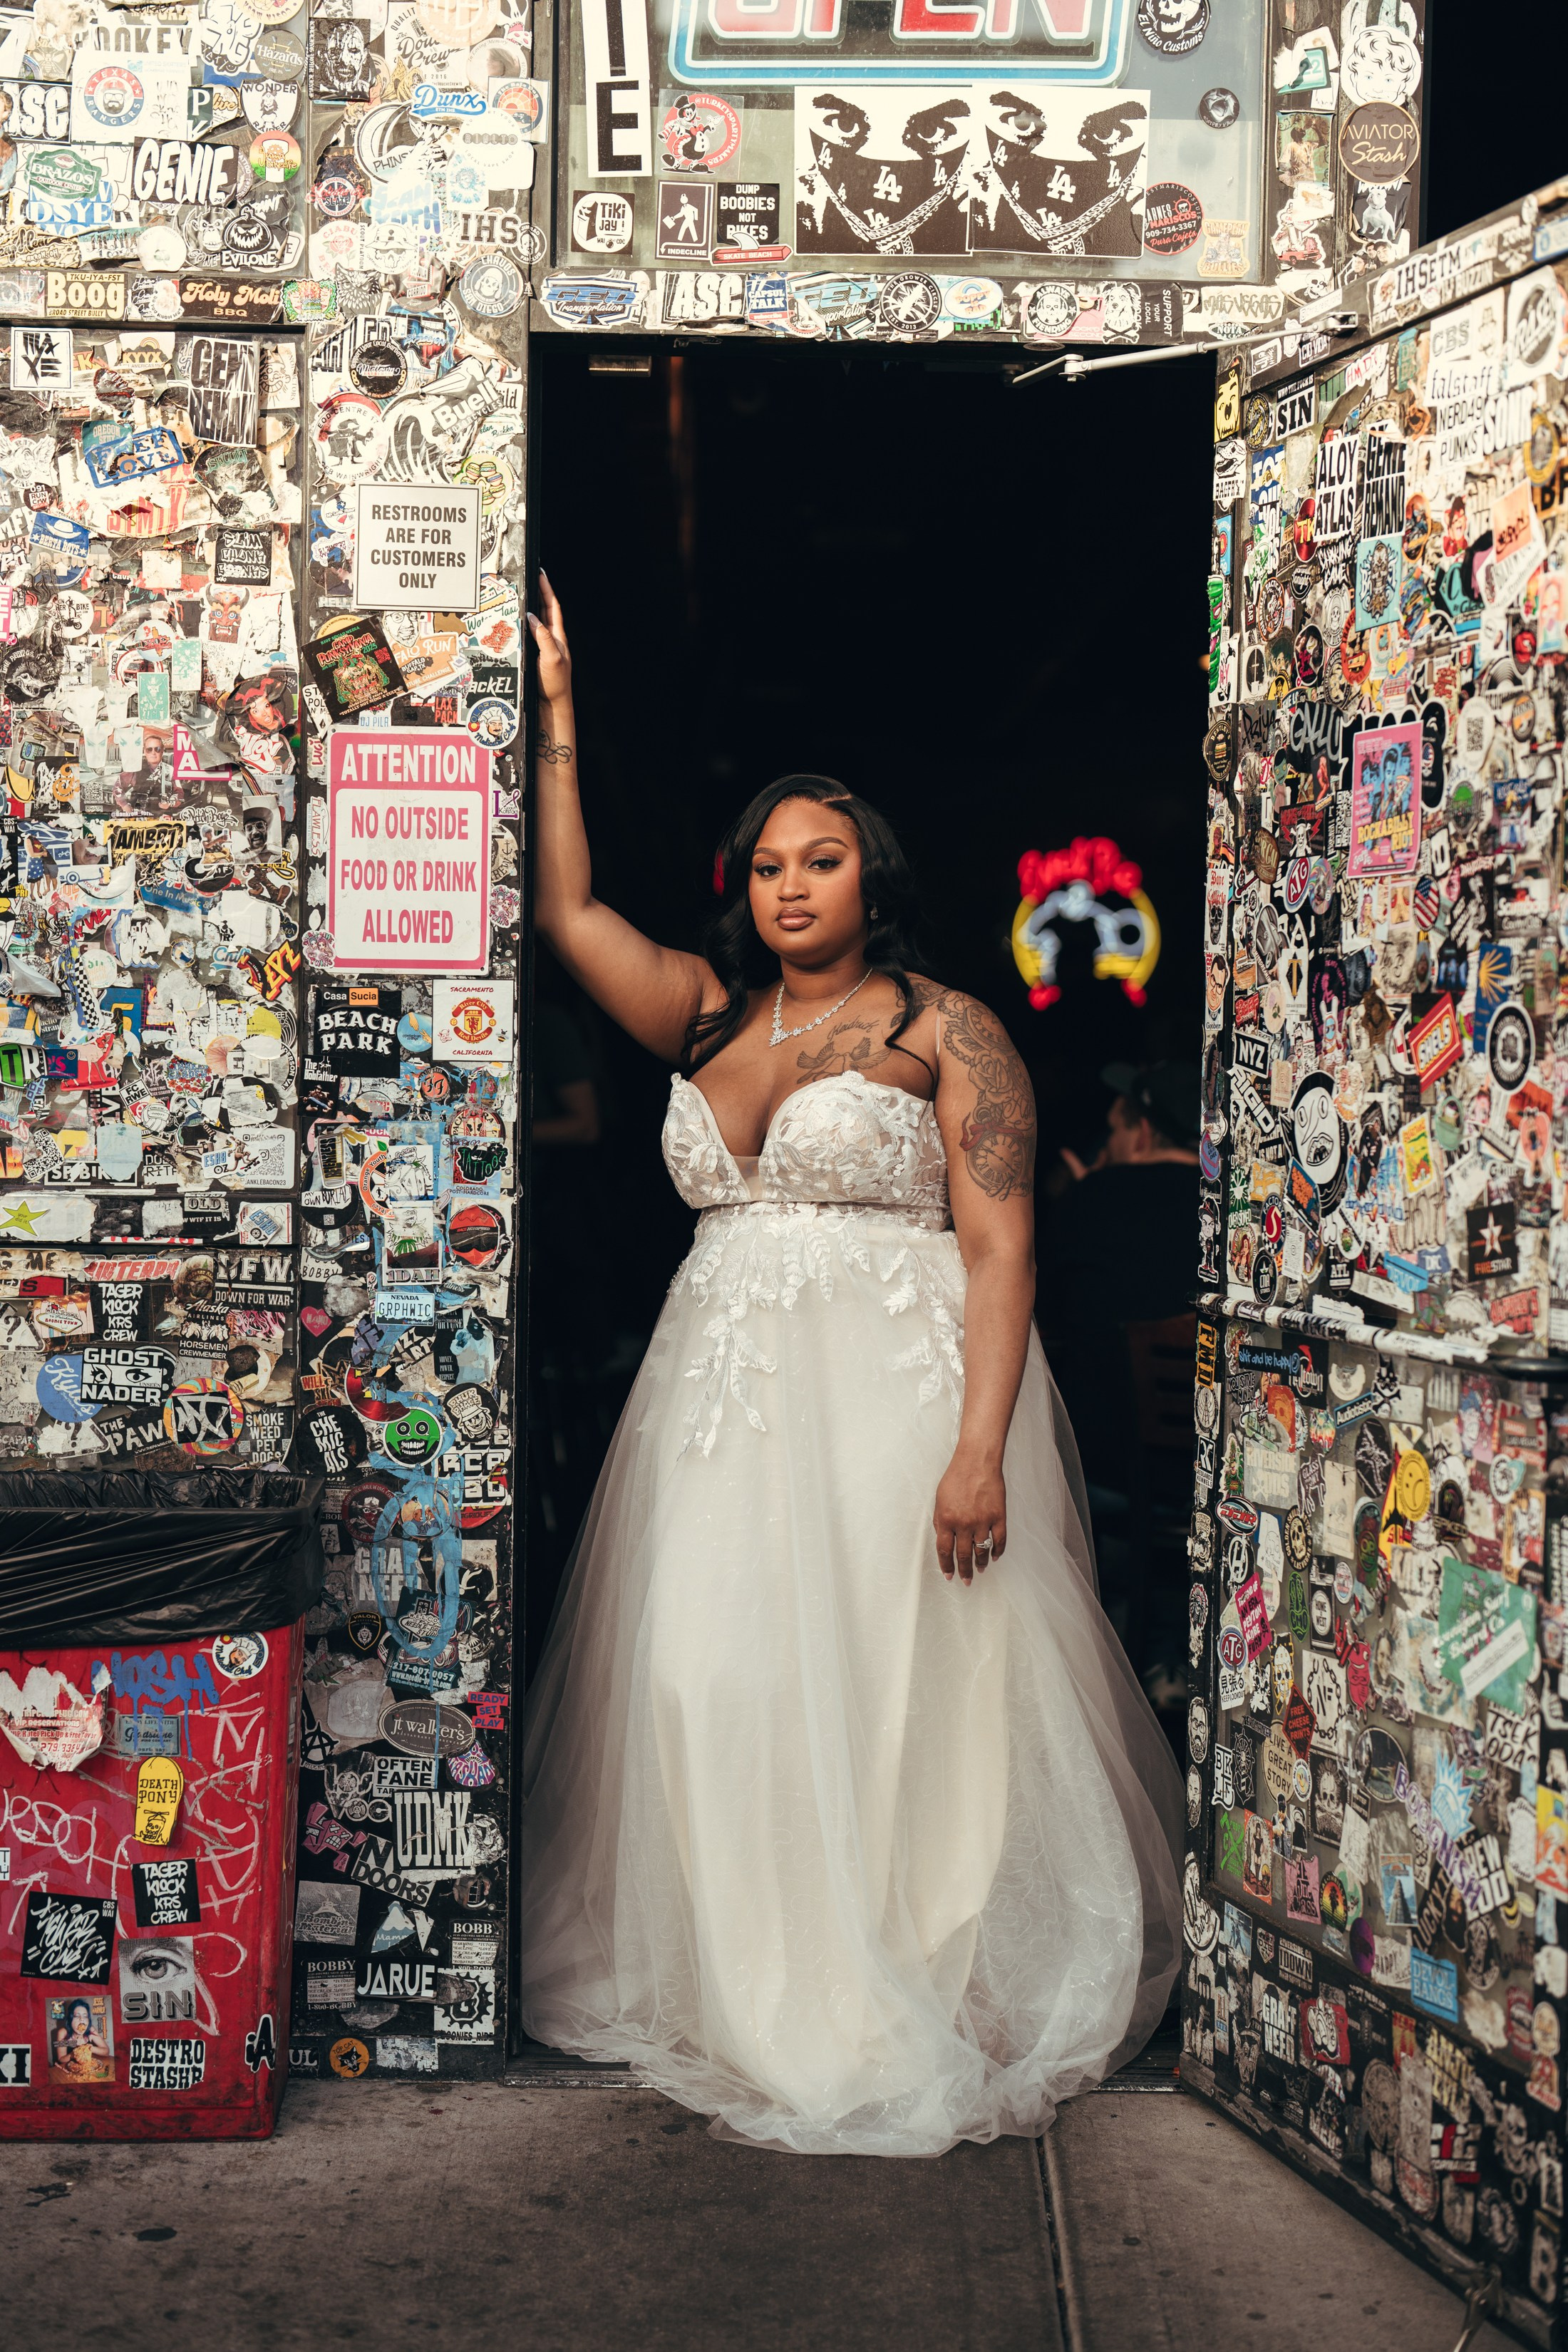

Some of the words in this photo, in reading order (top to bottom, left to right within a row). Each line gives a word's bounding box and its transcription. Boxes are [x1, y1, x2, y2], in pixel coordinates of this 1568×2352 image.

[257, 45, 302, 65] Hazards
[93, 68, 136, 85] TEXAS
[243, 83, 296, 93] WONDER
[87, 99, 140, 124] RANGERS
[463, 133, 517, 145] RIALTO
[1343, 123, 1413, 140] AVIATOR
[1351, 142, 1406, 165] Stash
[32, 163, 93, 185] BRAZOS
[135, 139, 234, 205] GENIE
[736, 185, 760, 194] DUMP
[326, 197, 350, 205] SLATE
[721, 197, 775, 210] BOOBIES
[739, 213, 755, 222] NOT
[1150, 211, 1197, 229] MARISCOS
[460, 212, 520, 245] IHS
[1145, 221, 1197, 238] 909-734-3367
[48, 272, 125, 319] Boog
[669, 273, 743, 319] ASC
[956, 291, 991, 304] POPPY
[1036, 284, 1071, 298] ALWAYS
[557, 302, 624, 314] Transportation
[1163, 289, 1172, 336] SUPPORT
[1032, 318, 1073, 334] FIENDING
[1433, 319, 1470, 356] CBS
[123, 352, 163, 363] KYYX
[1432, 366, 1492, 399] falstaff
[435, 377, 498, 428] Buell
[445, 400, 502, 435] MOTORCYCLES
[1277, 391, 1313, 435] SIN
[1440, 430, 1478, 467] PUNKS
[1319, 438, 1358, 490] ALOY
[371, 505, 467, 523] RESTROOMS
[1314, 488, 1354, 537] ATLAS
[39, 535, 61, 550] BERTA
[62, 540, 81, 555] BOYS
[385, 528, 417, 545] ARE
[421, 529, 452, 545] FOR
[371, 549, 466, 568] CUSTOMERS
[399, 572, 437, 589] ONLY
[316, 632, 376, 667] PUNKSYLVANIA
[362, 643, 378, 654] 2025
[423, 636, 454, 654] RUN
[423, 667, 451, 681] CHALLENGE
[341, 743, 476, 783] ATTENTION
[351, 806, 378, 839] NO
[385, 807, 469, 840] OUTSIDE
[1357, 811, 1415, 844] ROCKABILLY
[1391, 828, 1415, 850] RIOT
[341, 860, 386, 891] FOOD
[393, 860, 417, 892] OR
[423, 861, 477, 892] DRINK
[1289, 860, 1307, 901] ATG
[144, 887, 162, 899] One
[175, 892, 202, 907] Music
[362, 909, 453, 944] ALLOWED
[323, 991, 347, 1000] Casa
[351, 992, 377, 1001] Sucia
[317, 1011, 397, 1034] BEACH
[321, 1033, 392, 1056] PARK
[1239, 1038, 1266, 1069] NYZ
[304, 1058, 317, 1071] The
[304, 1071, 338, 1082] Bobfather
[125, 1085, 139, 1095] FC
[125, 1090, 148, 1106] RWE
[1230, 1069, 1275, 1133] RIGID
[368, 1153, 387, 1166] Youth
[188, 1197, 221, 1210] OLD
[1331, 1264, 1350, 1278] ATL
[98, 1284, 143, 1299] TAGER
[216, 1291, 244, 1303] DOWN
[247, 1292, 266, 1304] FOR
[268, 1293, 291, 1306] WAR
[102, 1299, 138, 1315] KLOCK
[186, 1299, 229, 1314] Alaska
[378, 1302, 430, 1316] GRPHWIC
[108, 1316, 133, 1329] KRS
[187, 1313, 225, 1321] AIRLINES
[103, 1329, 138, 1342] CREW
[180, 1341, 228, 1351] HORSEMEN
[180, 1350, 227, 1359] CREWMEMBER
[83, 1348, 160, 1364] GHOST
[82, 1384, 161, 1403] NADER
[100, 1418, 123, 1433] THE
[247, 1412, 284, 1425] SMOKE
[309, 1414, 341, 1436] CHE
[250, 1425, 280, 1439] WEED
[257, 1439, 276, 1452] PET
[315, 1430, 344, 1452] MIC
[326, 1447, 349, 1473] ALS
[1197, 1468, 1212, 1480] REDLANDS
[1197, 1475, 1212, 1487] KENNELS
[1243, 1604, 1262, 1631] PEYTON
[1224, 1636, 1242, 1661] ATG
[1248, 1636, 1262, 1654] FURY
[1222, 1673, 1244, 1695] 見張る
[470, 1693, 506, 1703] READY
[479, 1706, 497, 1715] SET
[1291, 1705, 1304, 1717] FREE
[406, 1718, 465, 1740] walker's
[474, 1718, 500, 1727] PLAY
[1289, 1715, 1309, 1728] CHEESE
[1290, 1728, 1310, 1740] PRINTS
[1268, 1750, 1292, 1775] GREAT
[140, 1779, 177, 1789] DEATH
[1267, 1768, 1291, 1795] STORY
[139, 1790, 177, 1803] PONY
[394, 1791, 473, 1868] UDMK
[140, 1861, 187, 1879] TAGER
[146, 1878, 186, 1898] KLOCK
[356, 1861, 430, 1905] DOORS
[103, 1901, 115, 1909] CBS
[155, 1897, 181, 1912] KRS
[102, 1909, 114, 1919] WAI
[150, 1909, 187, 1925] CREW
[308, 1960, 356, 1972] BOBBY
[1414, 1979, 1455, 2009] BANGS
[124, 1989, 194, 2021] SIN
[1262, 1993, 1297, 2031] GRAFT
[333, 2043, 344, 2054] TOP
[344, 2041, 354, 2049] CAT
[1264, 2023, 1295, 2062] NEED
[130, 2039, 205, 2064] DESTRO
